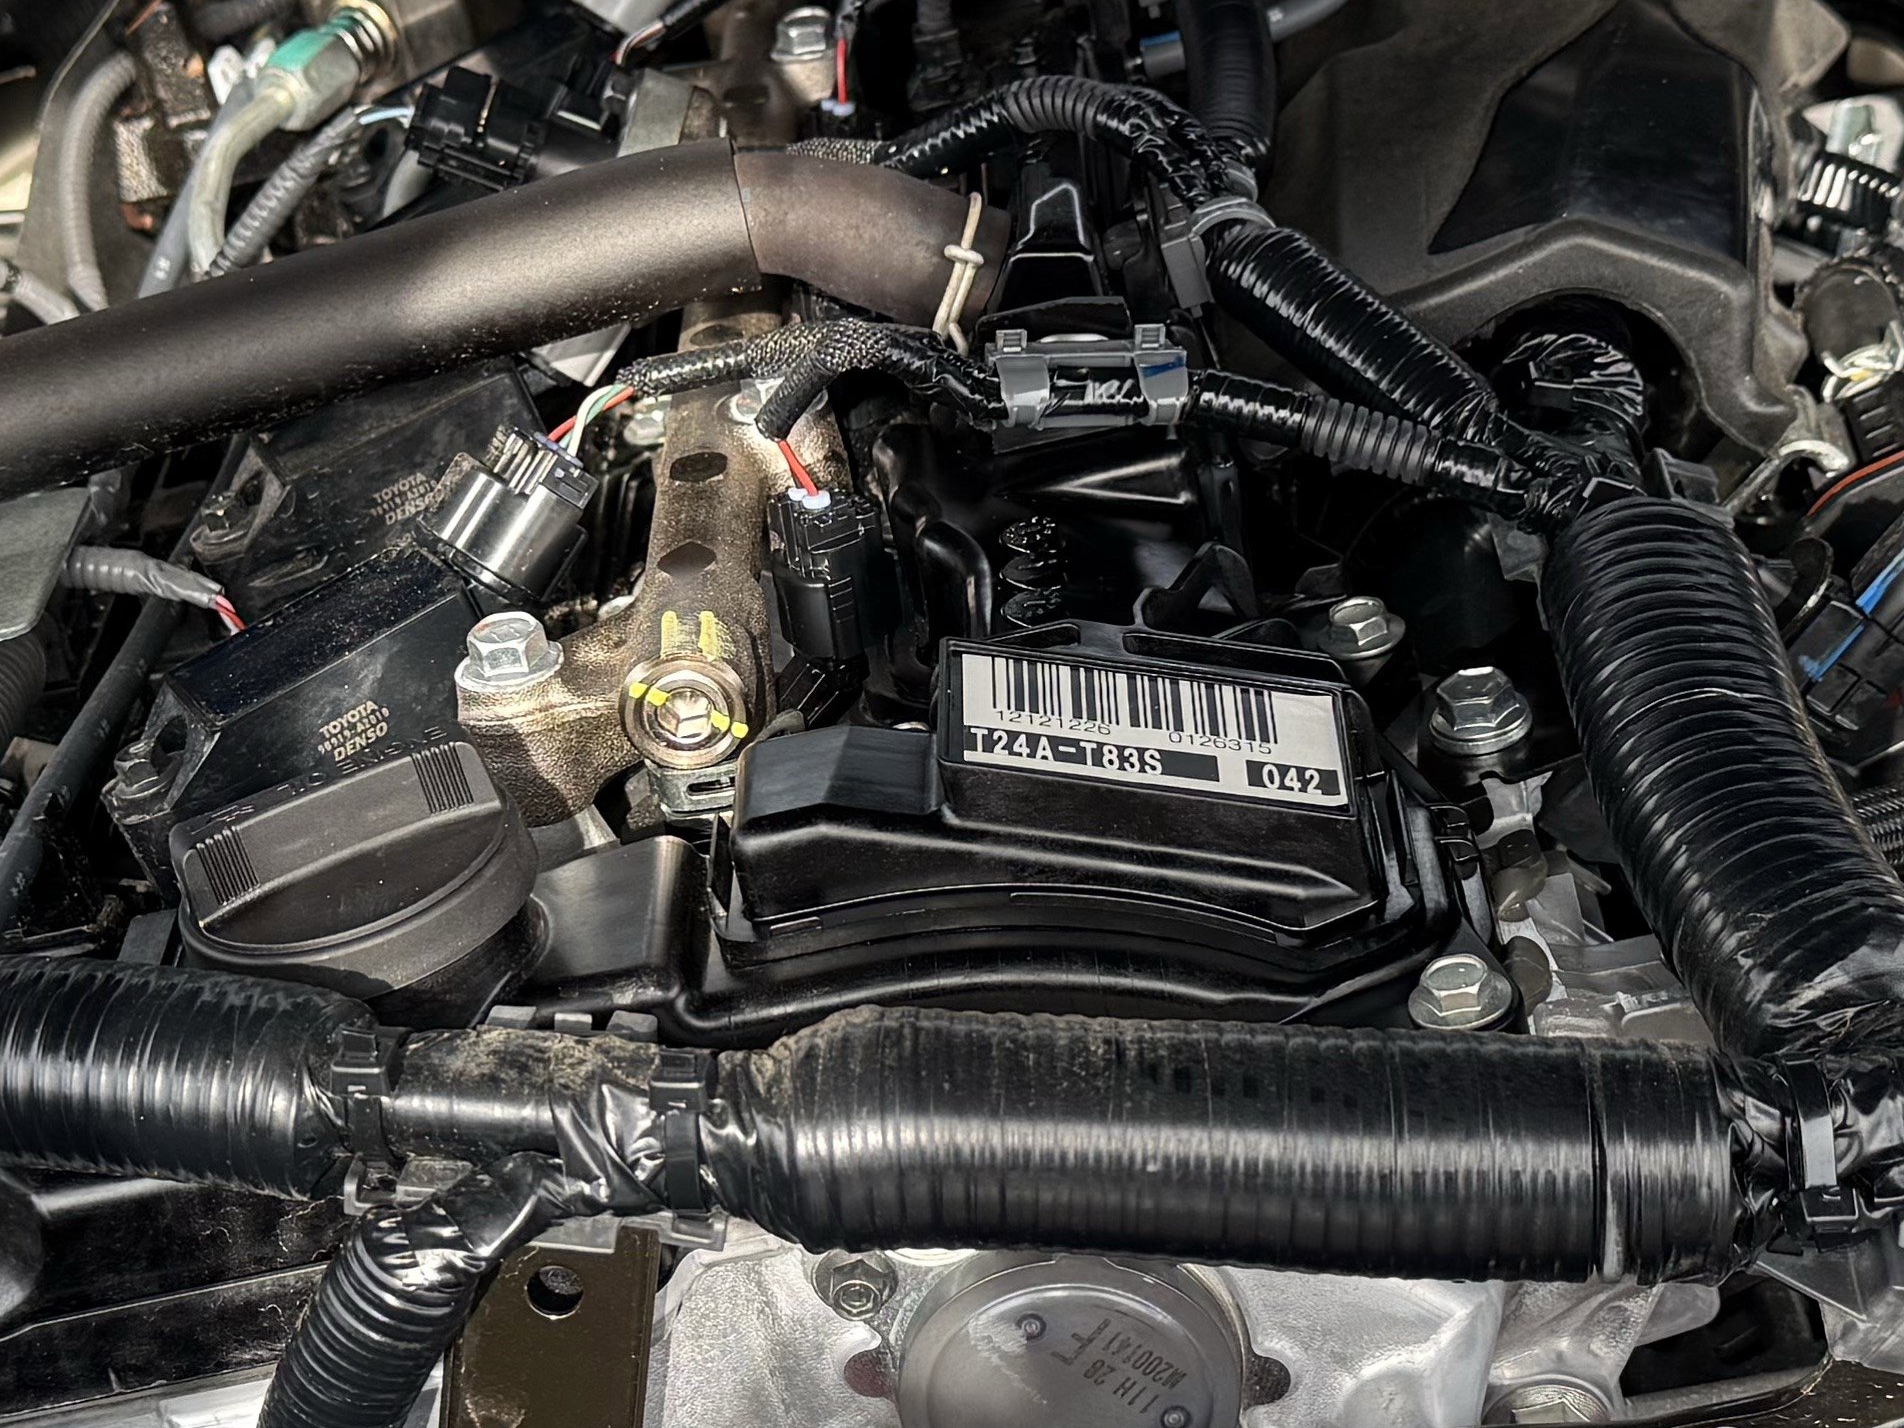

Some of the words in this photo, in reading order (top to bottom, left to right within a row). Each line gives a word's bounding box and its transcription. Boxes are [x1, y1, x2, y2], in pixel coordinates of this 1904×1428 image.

[372, 472, 427, 503] TOYOTA
[385, 491, 433, 525] DENSO
[319, 700, 379, 738] TOYOTA
[996, 710, 1112, 736] 12121226
[1169, 731, 1272, 755] 0126315
[334, 721, 388, 761] DENSO
[969, 727, 1163, 775] T24A-T83S
[1261, 764, 1323, 796] 042
